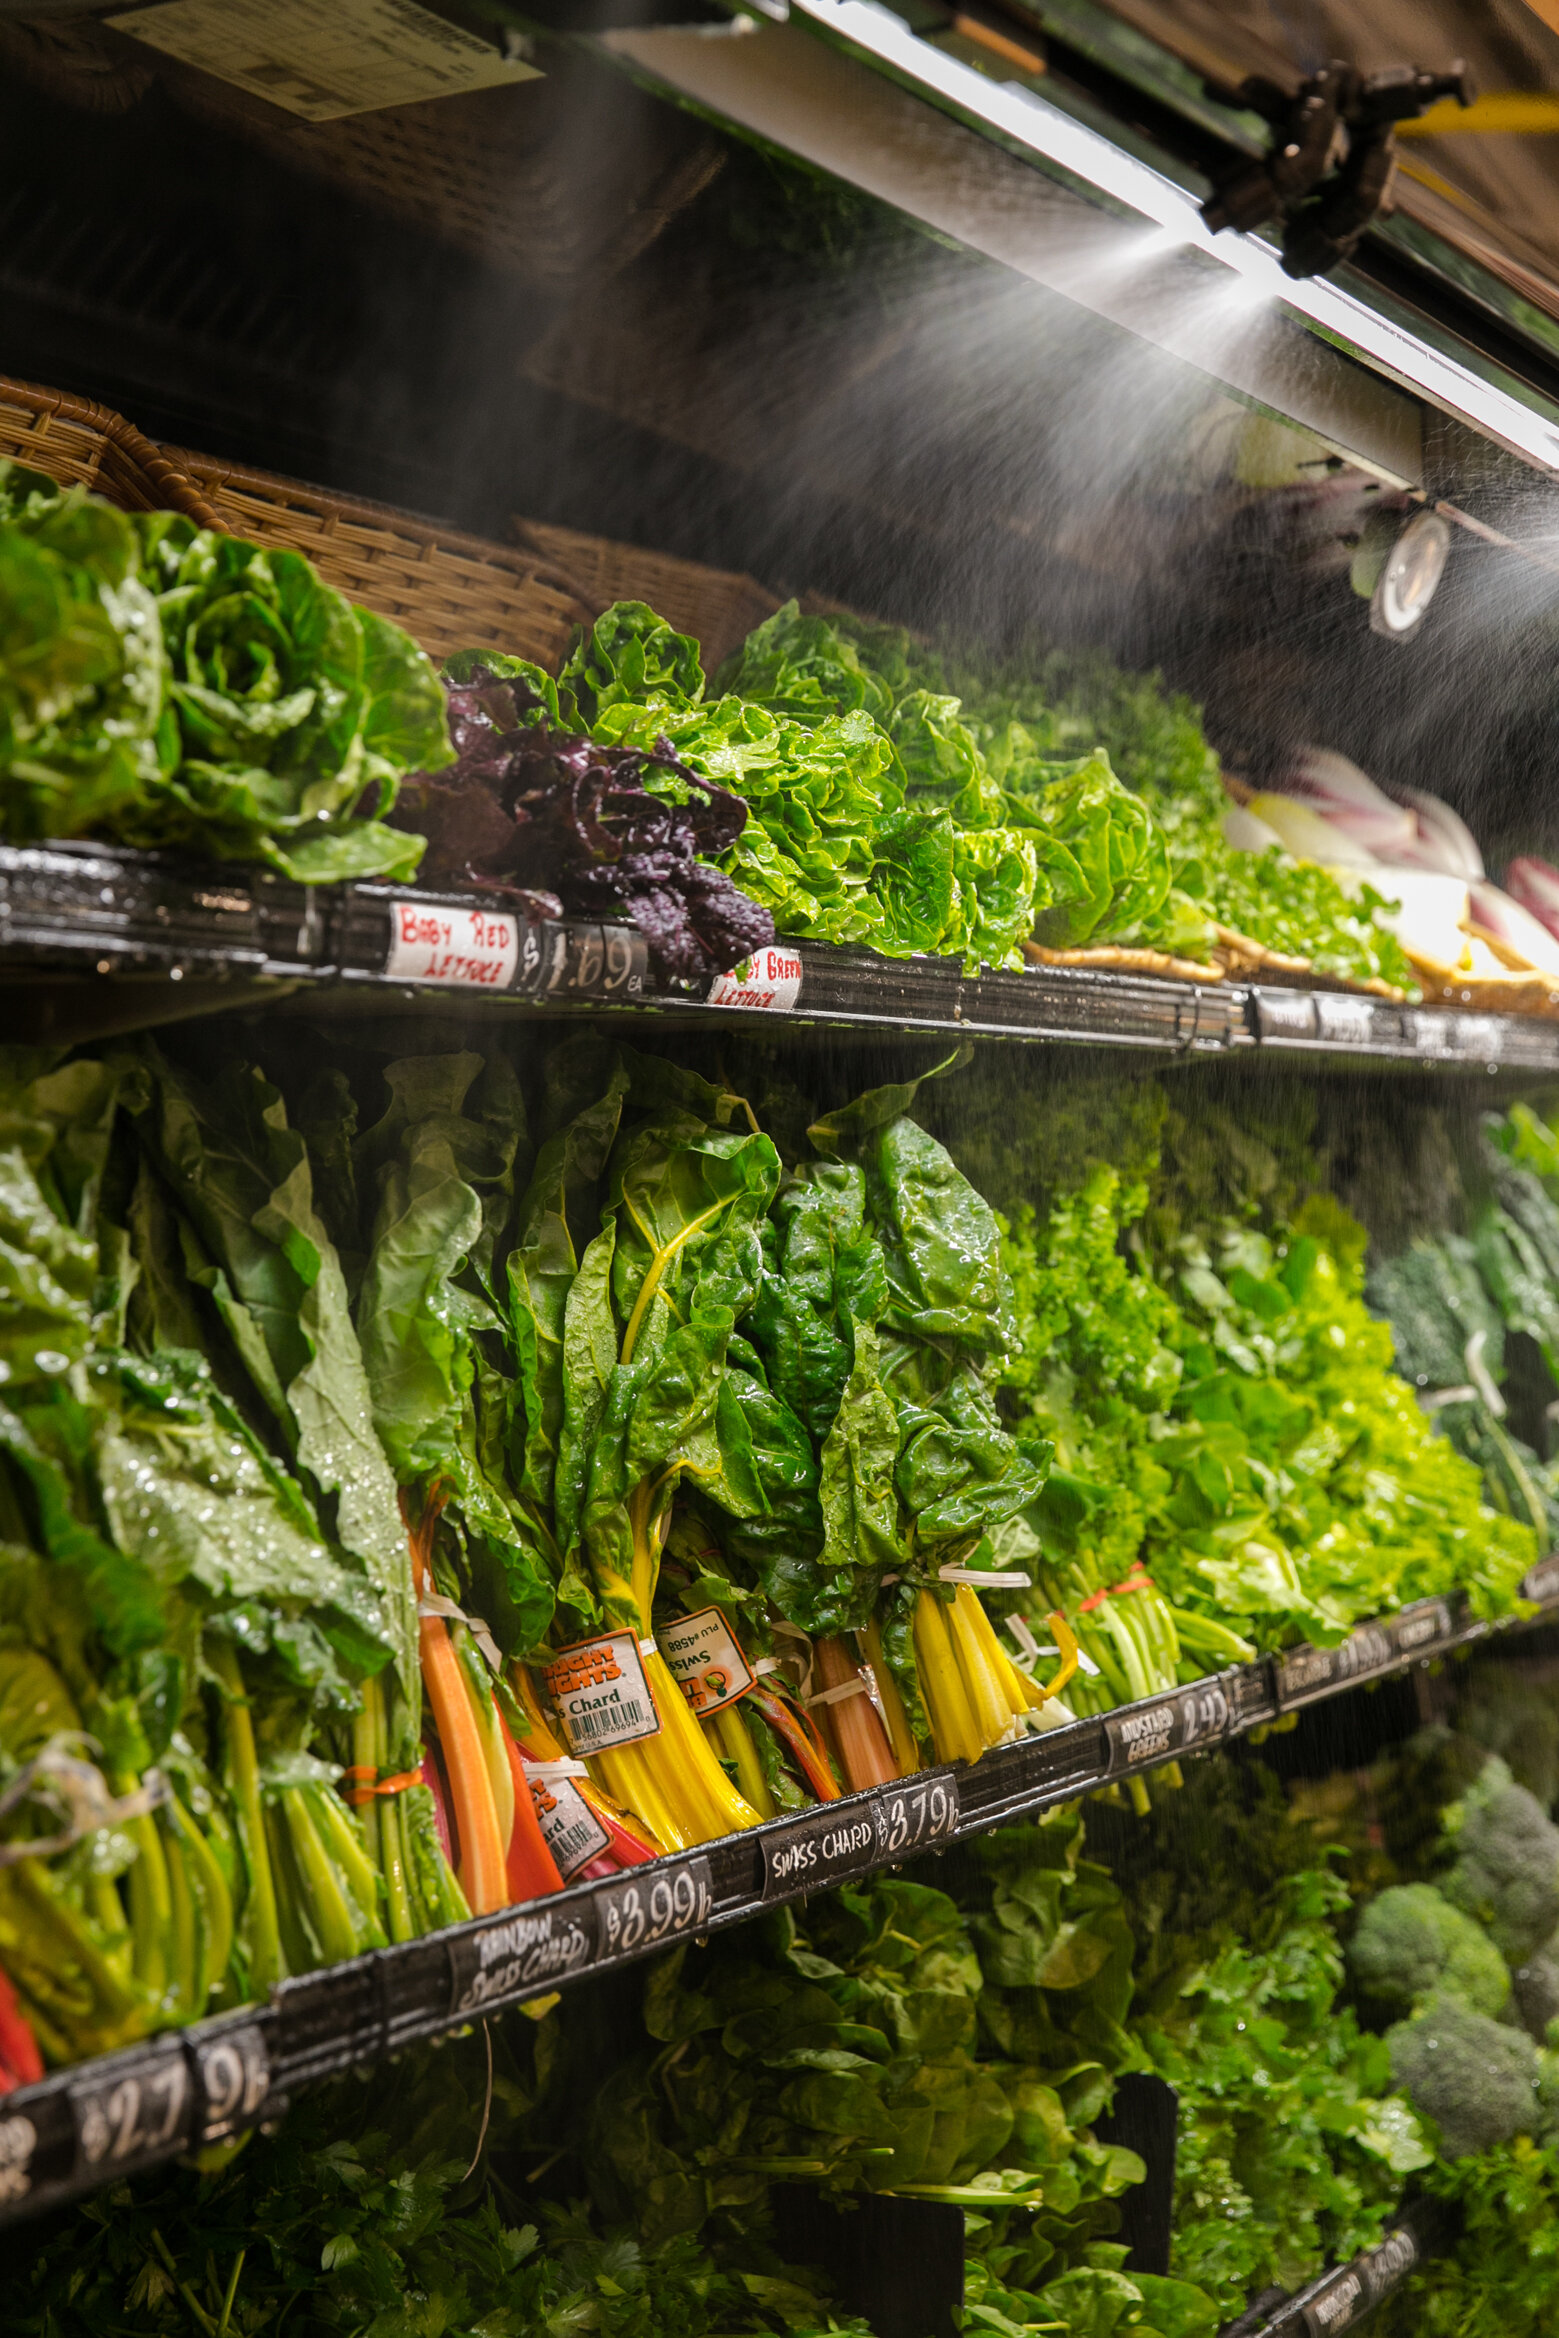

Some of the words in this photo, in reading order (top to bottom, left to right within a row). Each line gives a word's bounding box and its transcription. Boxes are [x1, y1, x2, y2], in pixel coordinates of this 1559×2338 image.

[469, 910, 510, 949] RED
[700, 1623, 719, 1638] PLU
[569, 1688, 621, 1715] Chard
[772, 1840, 817, 1879] SWISS
[822, 1822, 873, 1860] CHARD
